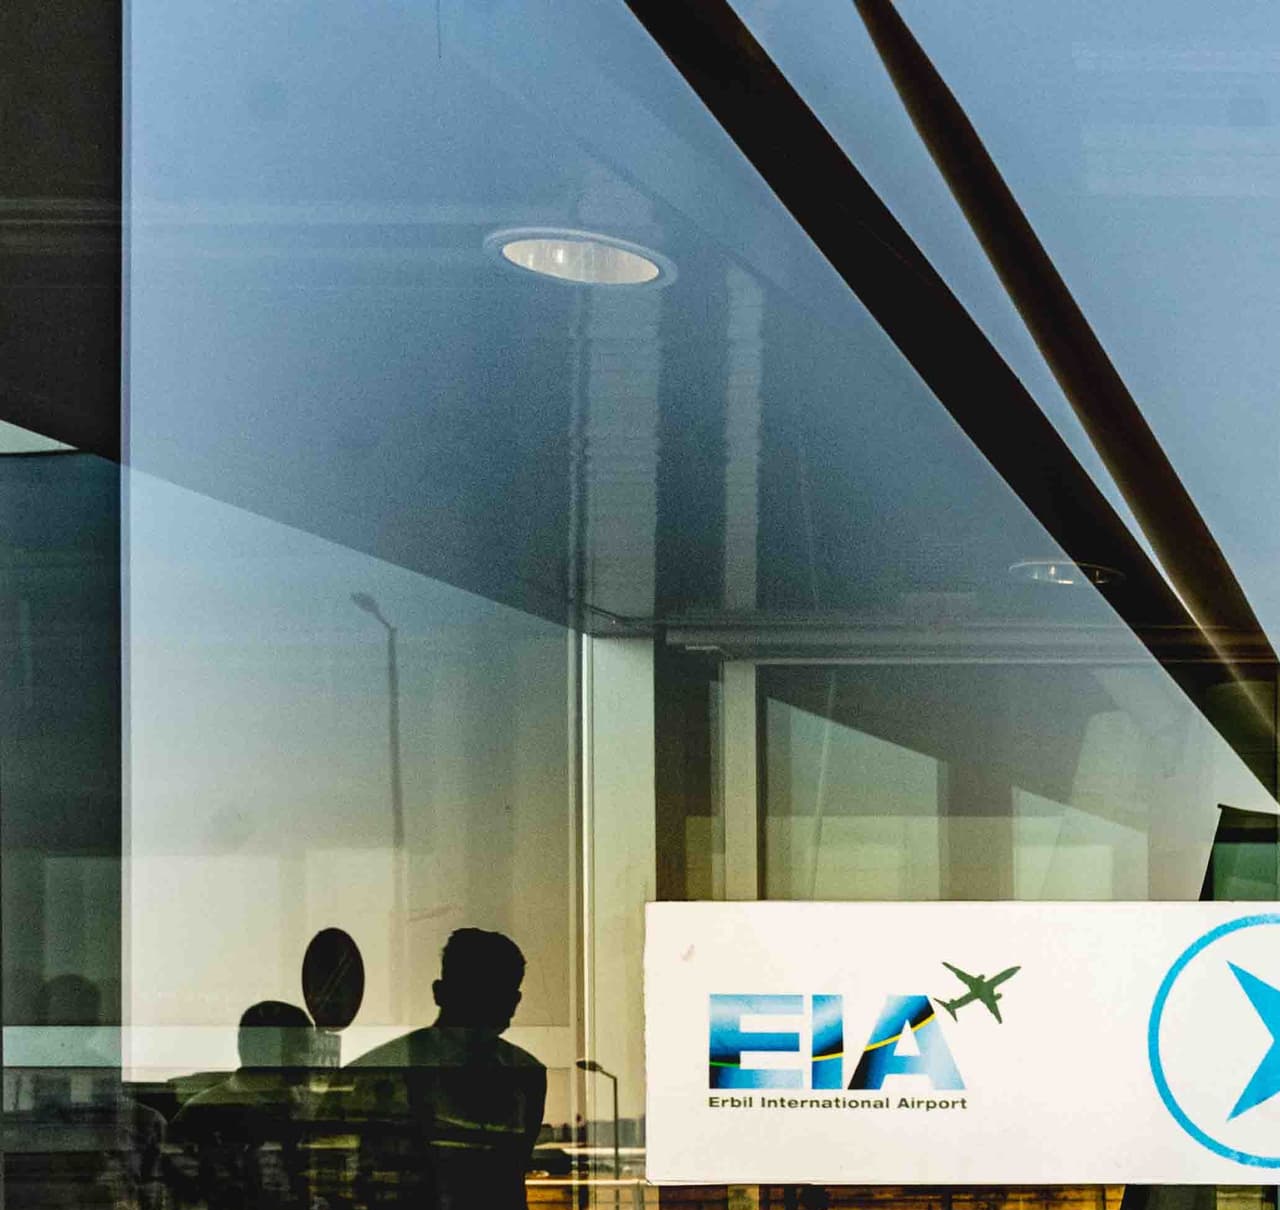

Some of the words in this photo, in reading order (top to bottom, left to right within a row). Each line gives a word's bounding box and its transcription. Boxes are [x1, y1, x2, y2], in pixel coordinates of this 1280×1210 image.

[709, 994, 966, 1090] EIA
[708, 1096, 753, 1108] Erbil
[760, 1096, 890, 1109] International
[897, 1096, 968, 1111] Airport
